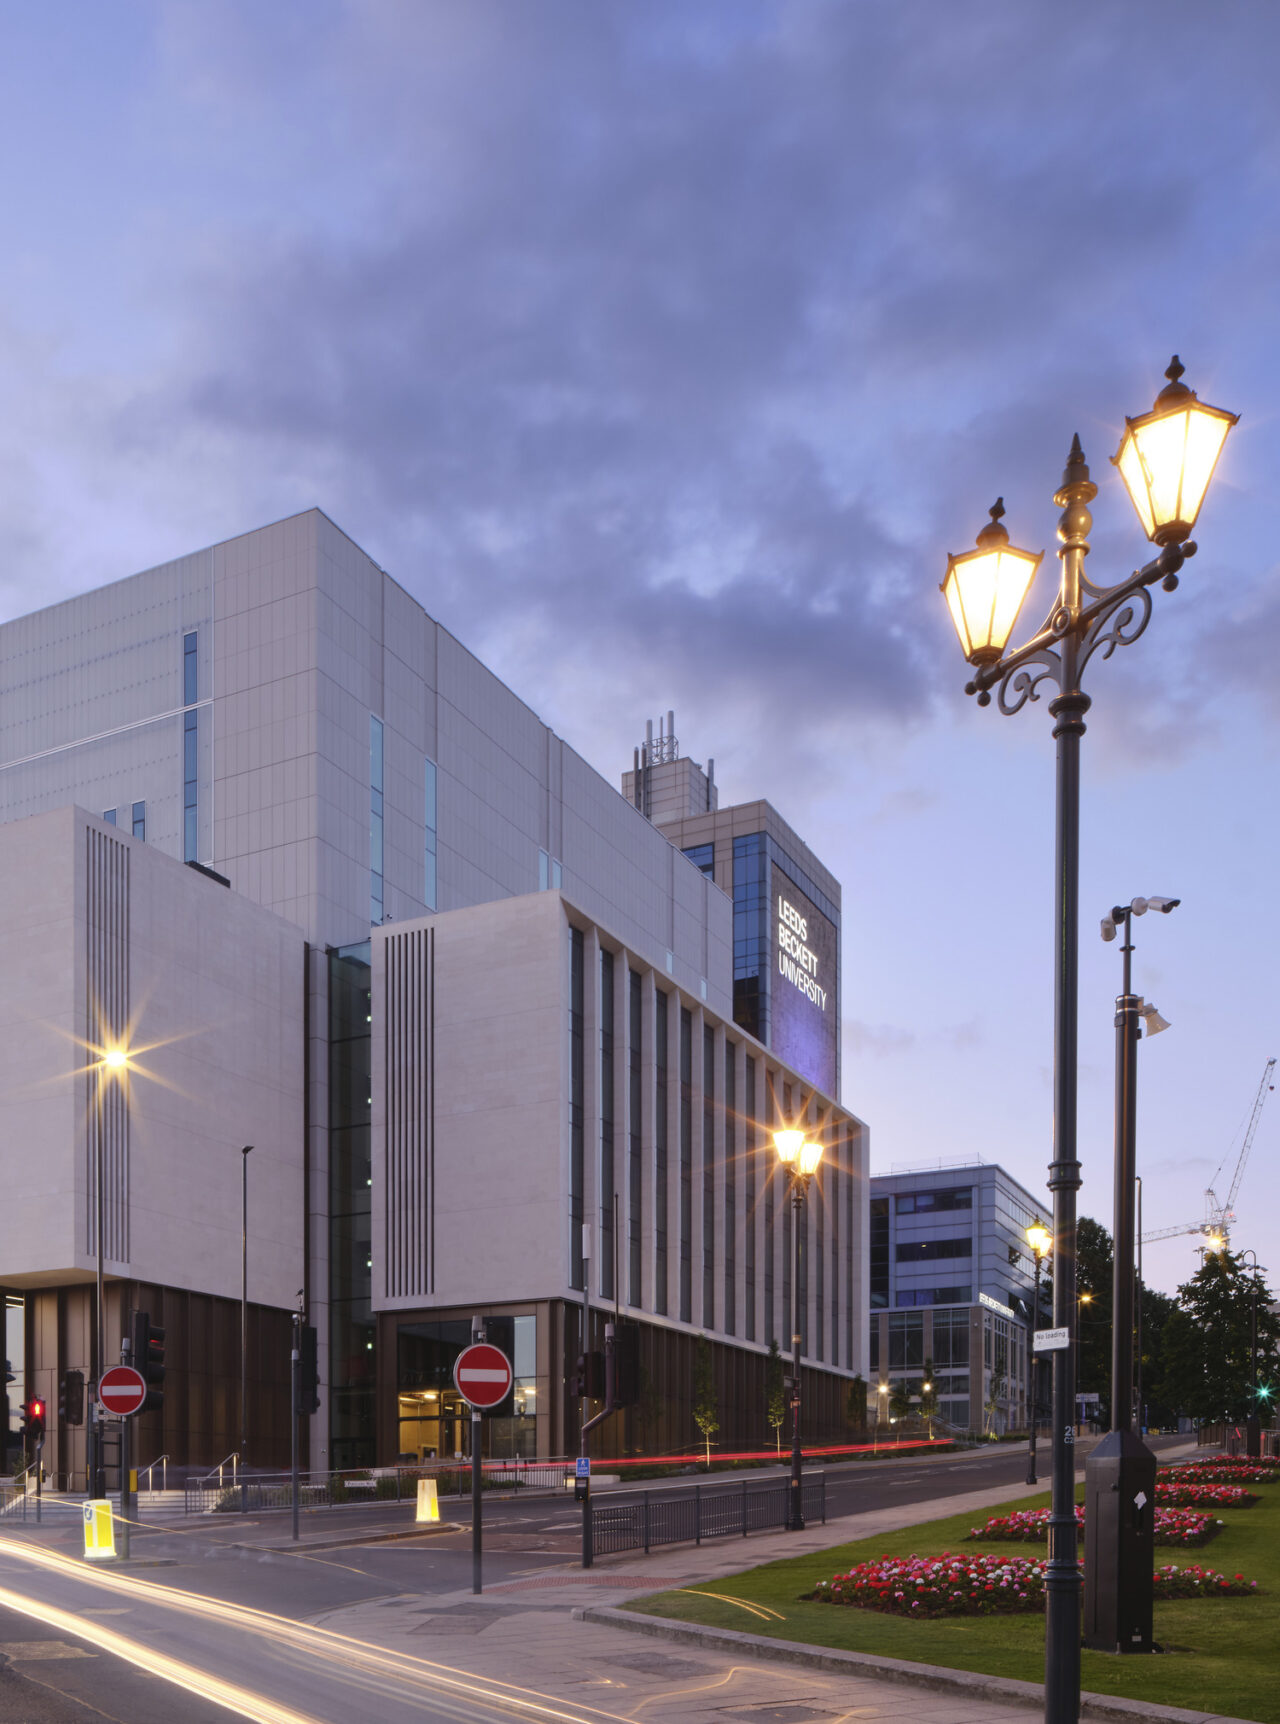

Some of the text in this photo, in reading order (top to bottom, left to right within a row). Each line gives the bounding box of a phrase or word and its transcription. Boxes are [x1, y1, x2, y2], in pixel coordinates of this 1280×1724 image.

[778, 895, 807, 941] LEEDS
[778, 922, 818, 977] BECKETT
[778, 950, 826, 1011] UNIVERSITY
[1045, 1331, 1066, 1339] loading
